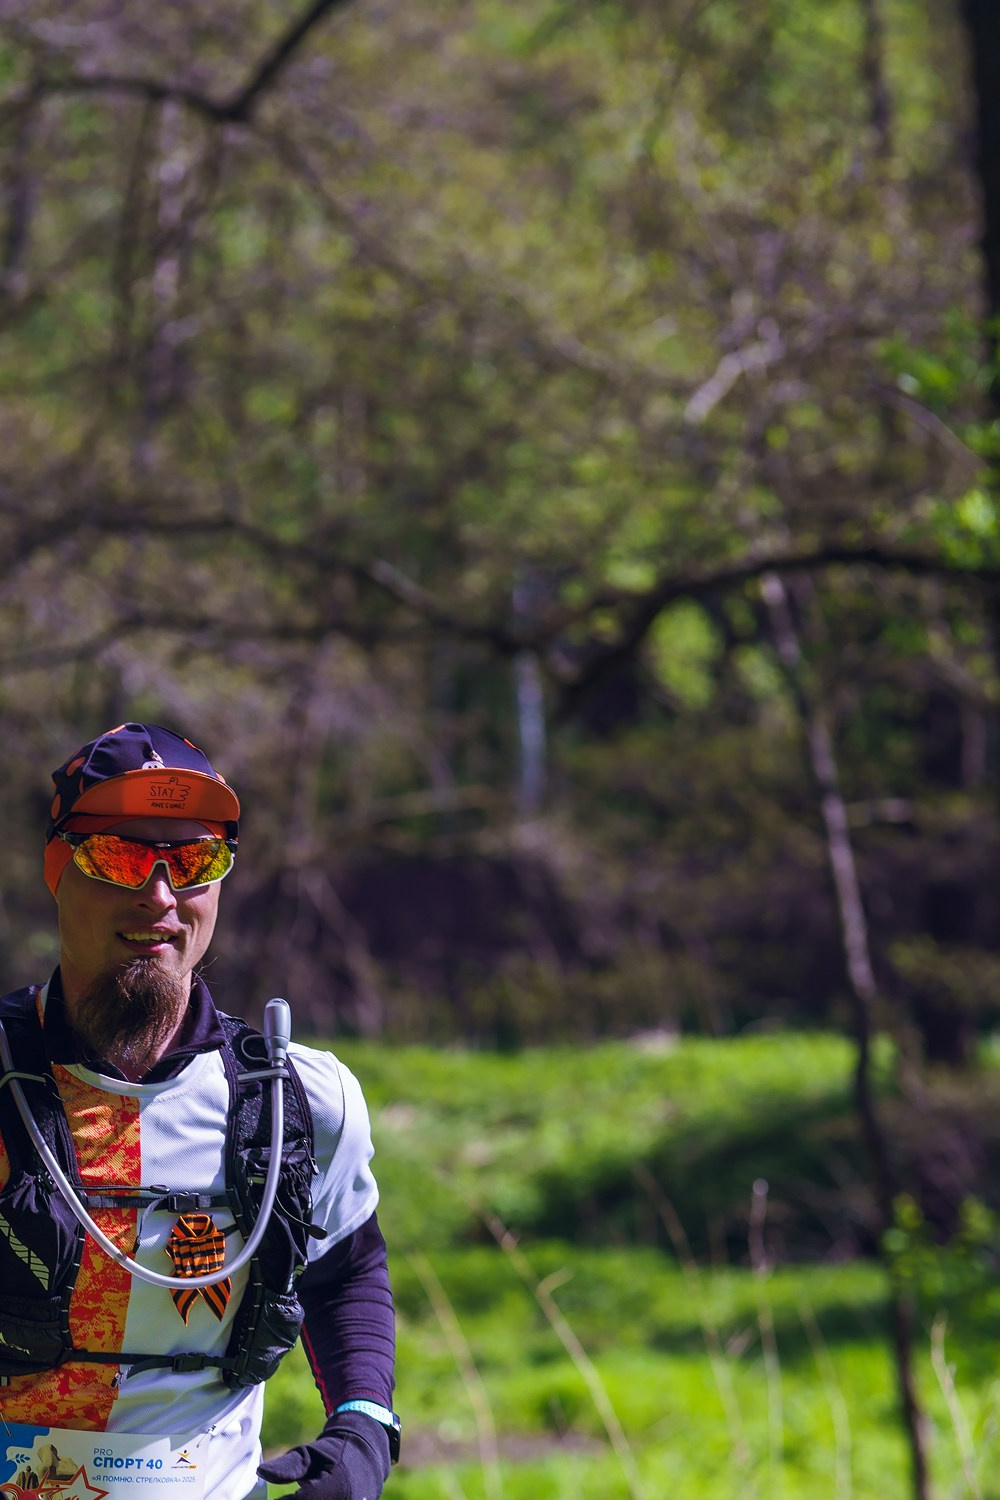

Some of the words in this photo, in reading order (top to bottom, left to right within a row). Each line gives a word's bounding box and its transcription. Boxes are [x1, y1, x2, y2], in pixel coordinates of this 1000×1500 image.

[150, 785, 174, 798] STAY
[151, 802, 186, 810] AWESOME!
[93, 1448, 113, 1456] PRO
[93, 1457, 144, 1469] СПОРТ
[146, 1459, 163, 1470] 40
